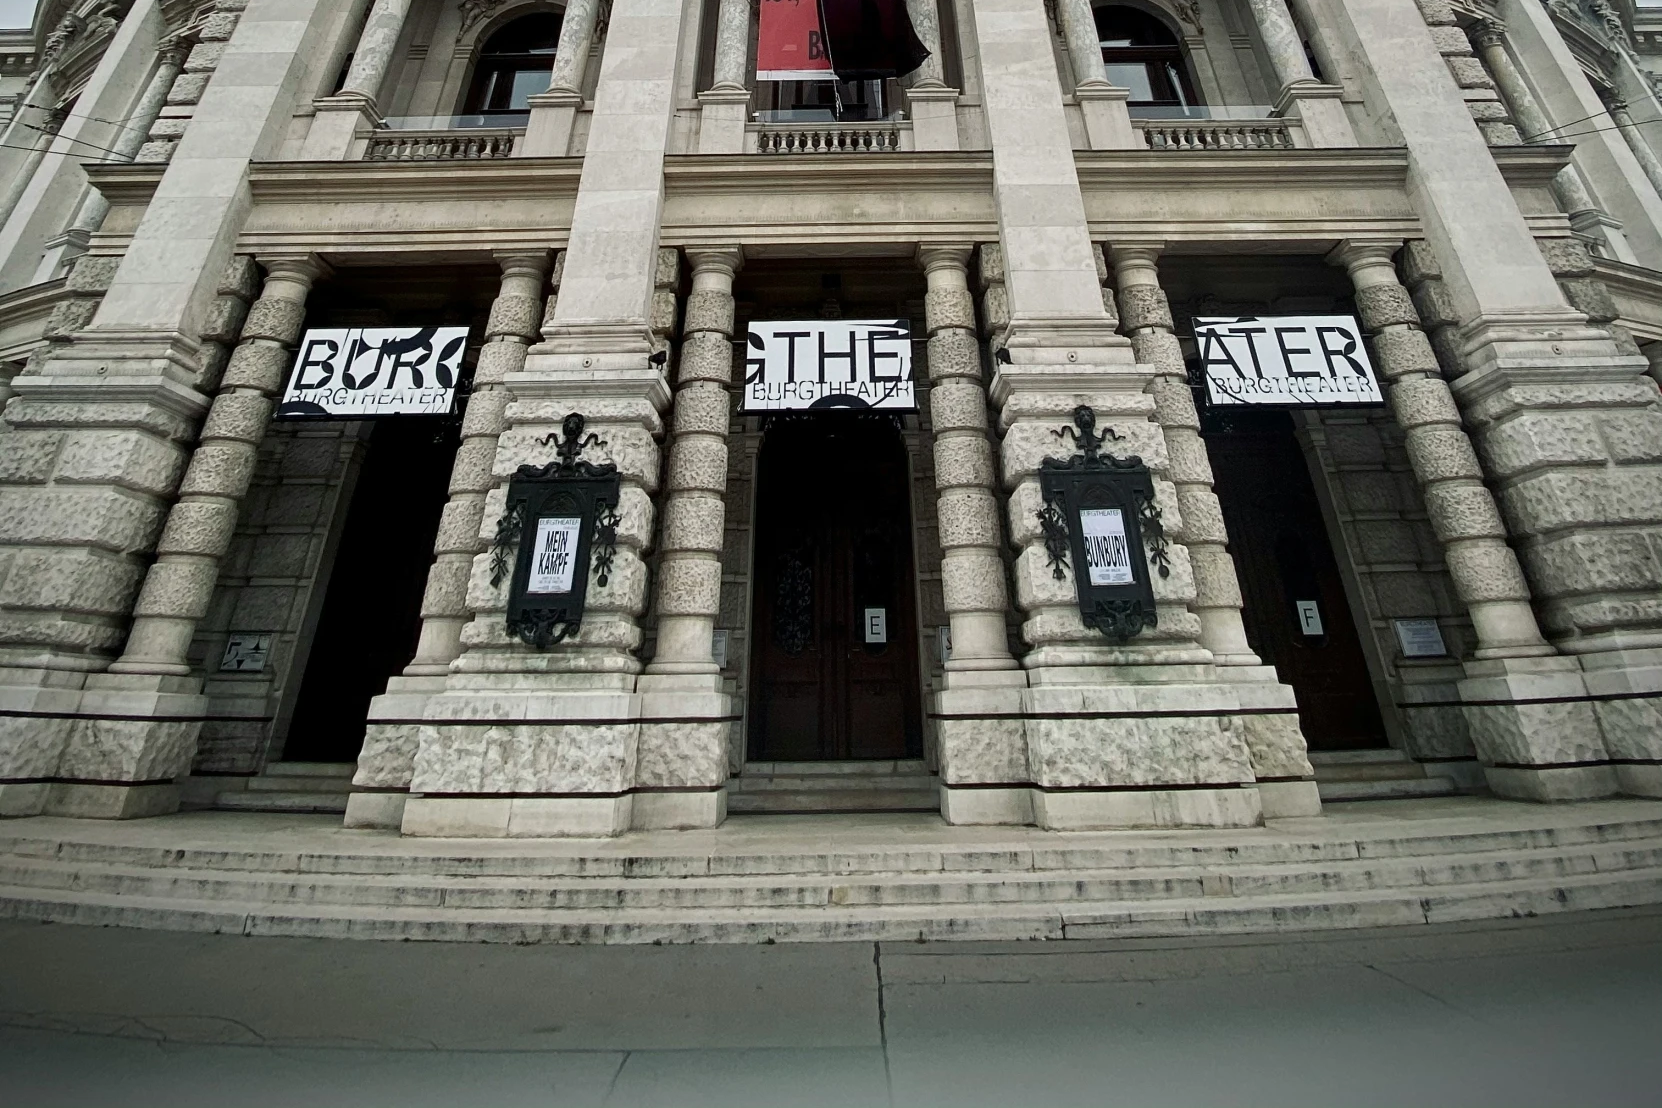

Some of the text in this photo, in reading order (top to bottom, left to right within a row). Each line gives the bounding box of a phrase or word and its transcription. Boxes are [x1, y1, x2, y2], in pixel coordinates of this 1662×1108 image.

[1202, 327, 1368, 378] ATER
[752, 380, 910, 401] BURGTHEATER
[1215, 375, 1374, 394] BURGTHEATER
[289, 386, 448, 406] BURGTHEATER
[545, 531, 569, 552] MEIN
[1084, 535, 1128, 567] BUNBURY
[537, 553, 569, 575] KAMPF
[870, 616, 881, 635] E
[1303, 608, 1314, 628] F
